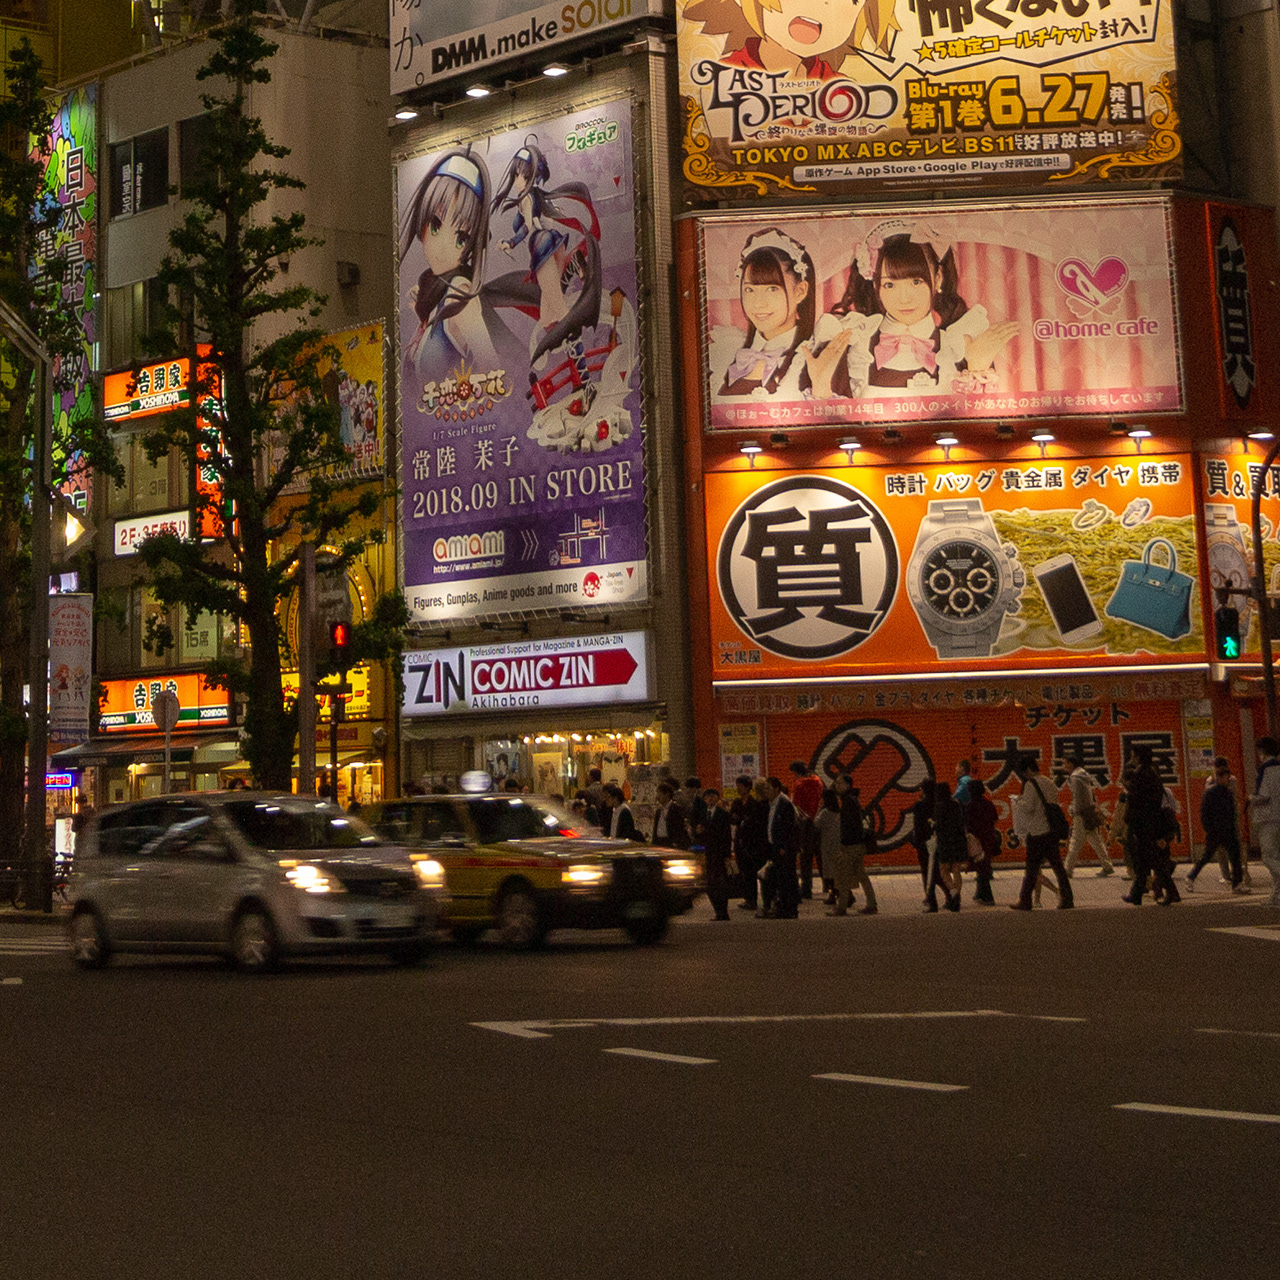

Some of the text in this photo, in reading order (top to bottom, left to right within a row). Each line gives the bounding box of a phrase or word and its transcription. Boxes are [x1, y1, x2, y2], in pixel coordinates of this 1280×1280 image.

[907, 81, 985, 101] Blu-ray
[987, 72, 1111, 128] 6.27
[908, 100, 986, 130] 第1巻
[564, 120, 619, 153] フィギュア
[731, 144, 809, 167] TOKYO
[857, 165, 881, 177] App
[1032, 316, 1159, 342] @home cafe
[137, 362, 182, 397] 吉野家
[138, 391, 180, 410] YOSHINOYA
[447, 425, 469, 439] Scale
[470, 422, 497, 435] Figure
[412, 460, 633, 519] 2018.09 IN STORE
[886, 462, 1182, 495] 時計 バッグ 貴金属 ダイヤ 携帯
[432, 529, 505, 562] amiami
[740, 501, 882, 638] 質
[413, 581, 578, 611] Figures, Gunplas, Anime goods and more
[407, 653, 434, 665] COMIC
[470, 634, 624, 657] Professional Support for Magazine & MANGA-ZIN
[720, 648, 762, 666] 大黒屋
[408, 650, 466, 710] ZIN
[472, 653, 596, 693] COMIC ZIN
[472, 693, 540, 709] Akihabara
[1025, 703, 1131, 730] チケット
